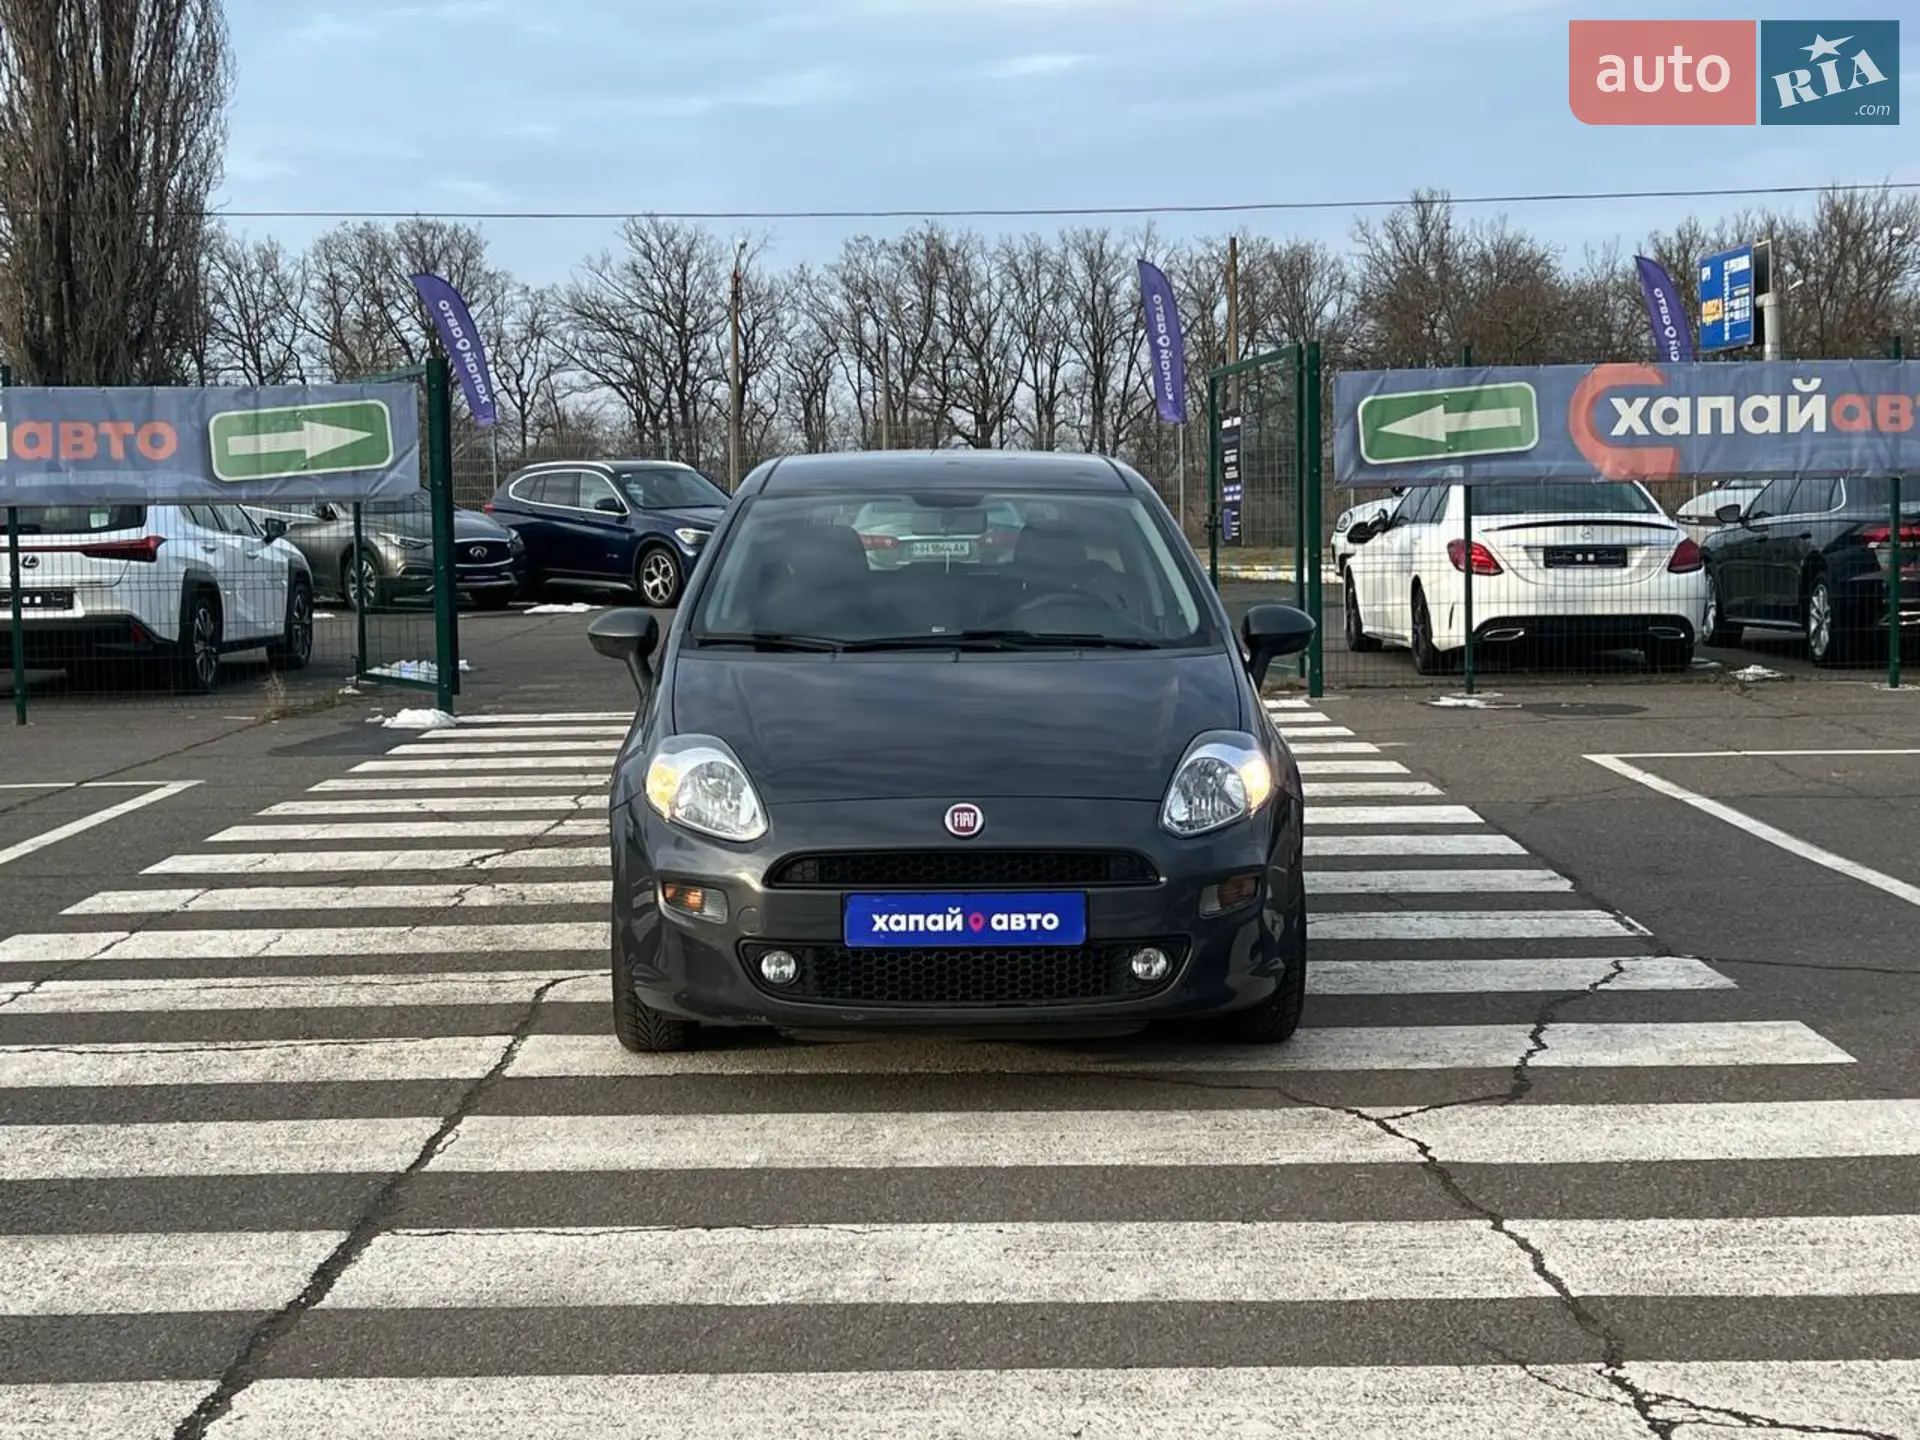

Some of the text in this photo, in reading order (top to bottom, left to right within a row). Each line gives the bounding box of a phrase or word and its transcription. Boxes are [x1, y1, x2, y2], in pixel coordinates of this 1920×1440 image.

[954, 812, 975, 827] FIAT
[871, 907, 1060, 932] хапай авто
